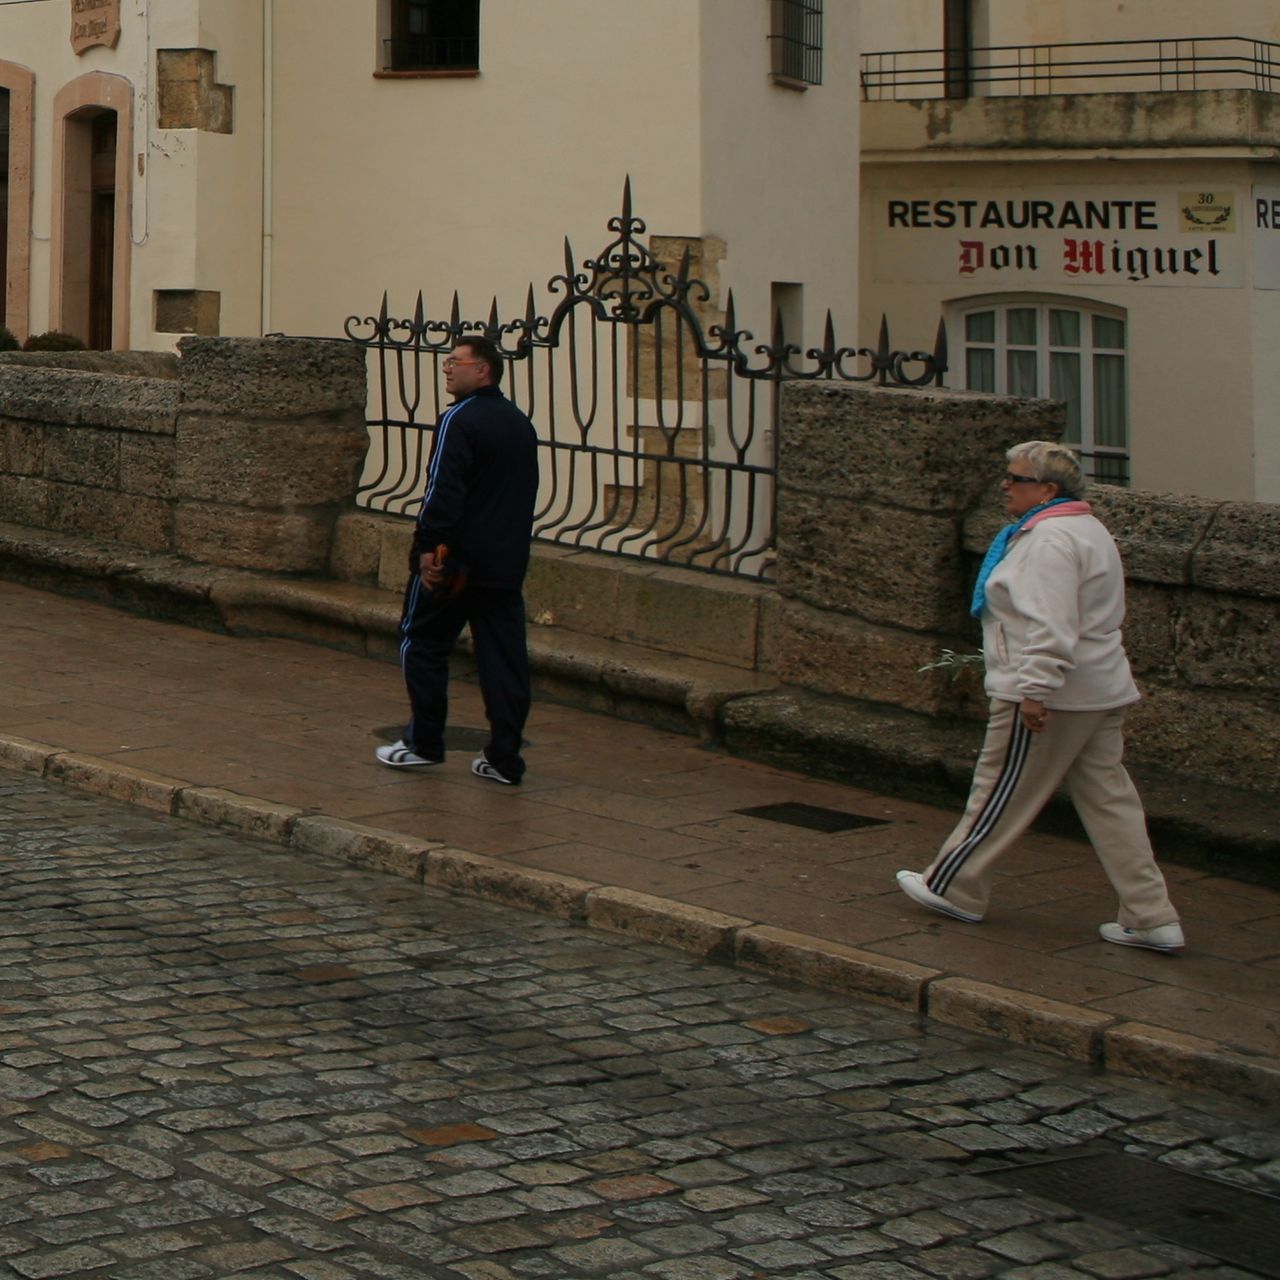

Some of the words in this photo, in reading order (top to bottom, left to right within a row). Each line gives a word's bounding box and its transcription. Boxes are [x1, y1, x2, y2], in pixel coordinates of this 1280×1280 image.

[1198, 192, 1214, 205] 30
[888, 200, 1158, 230] RESTAURANTE
[958, 239, 1039, 276] Don
[1062, 237, 1221, 282] Miguel
